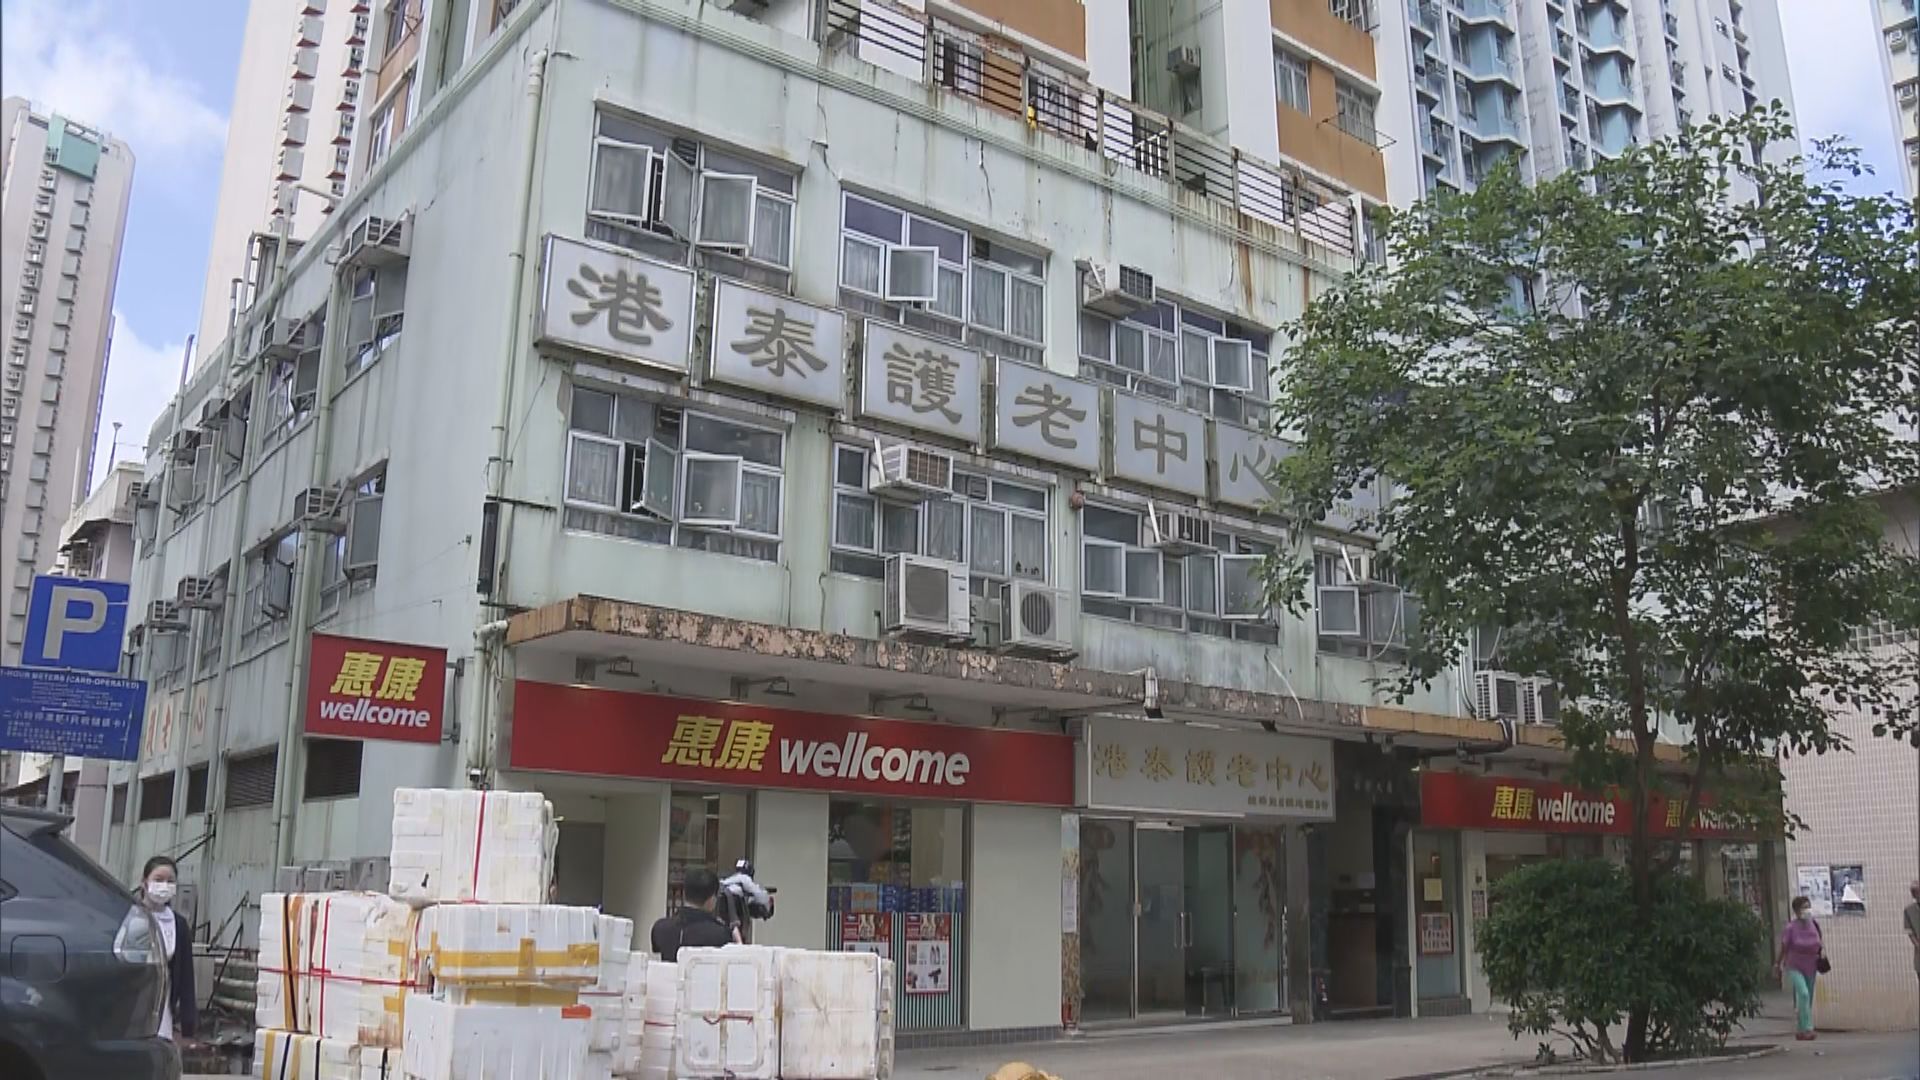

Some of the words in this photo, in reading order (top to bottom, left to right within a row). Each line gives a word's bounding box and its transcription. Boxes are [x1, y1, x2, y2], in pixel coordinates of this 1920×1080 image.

[566, 262, 1285, 500] 港泰護老中心
[42, 585, 108, 659] P
[330, 651, 427, 702] 惠康
[320, 698, 431, 728] wellcome
[661, 714, 774, 772] 惠康
[780, 731, 970, 786] wellcome
[1491, 785, 1534, 820] 惠康
[1538, 791, 1615, 825] wellcome
